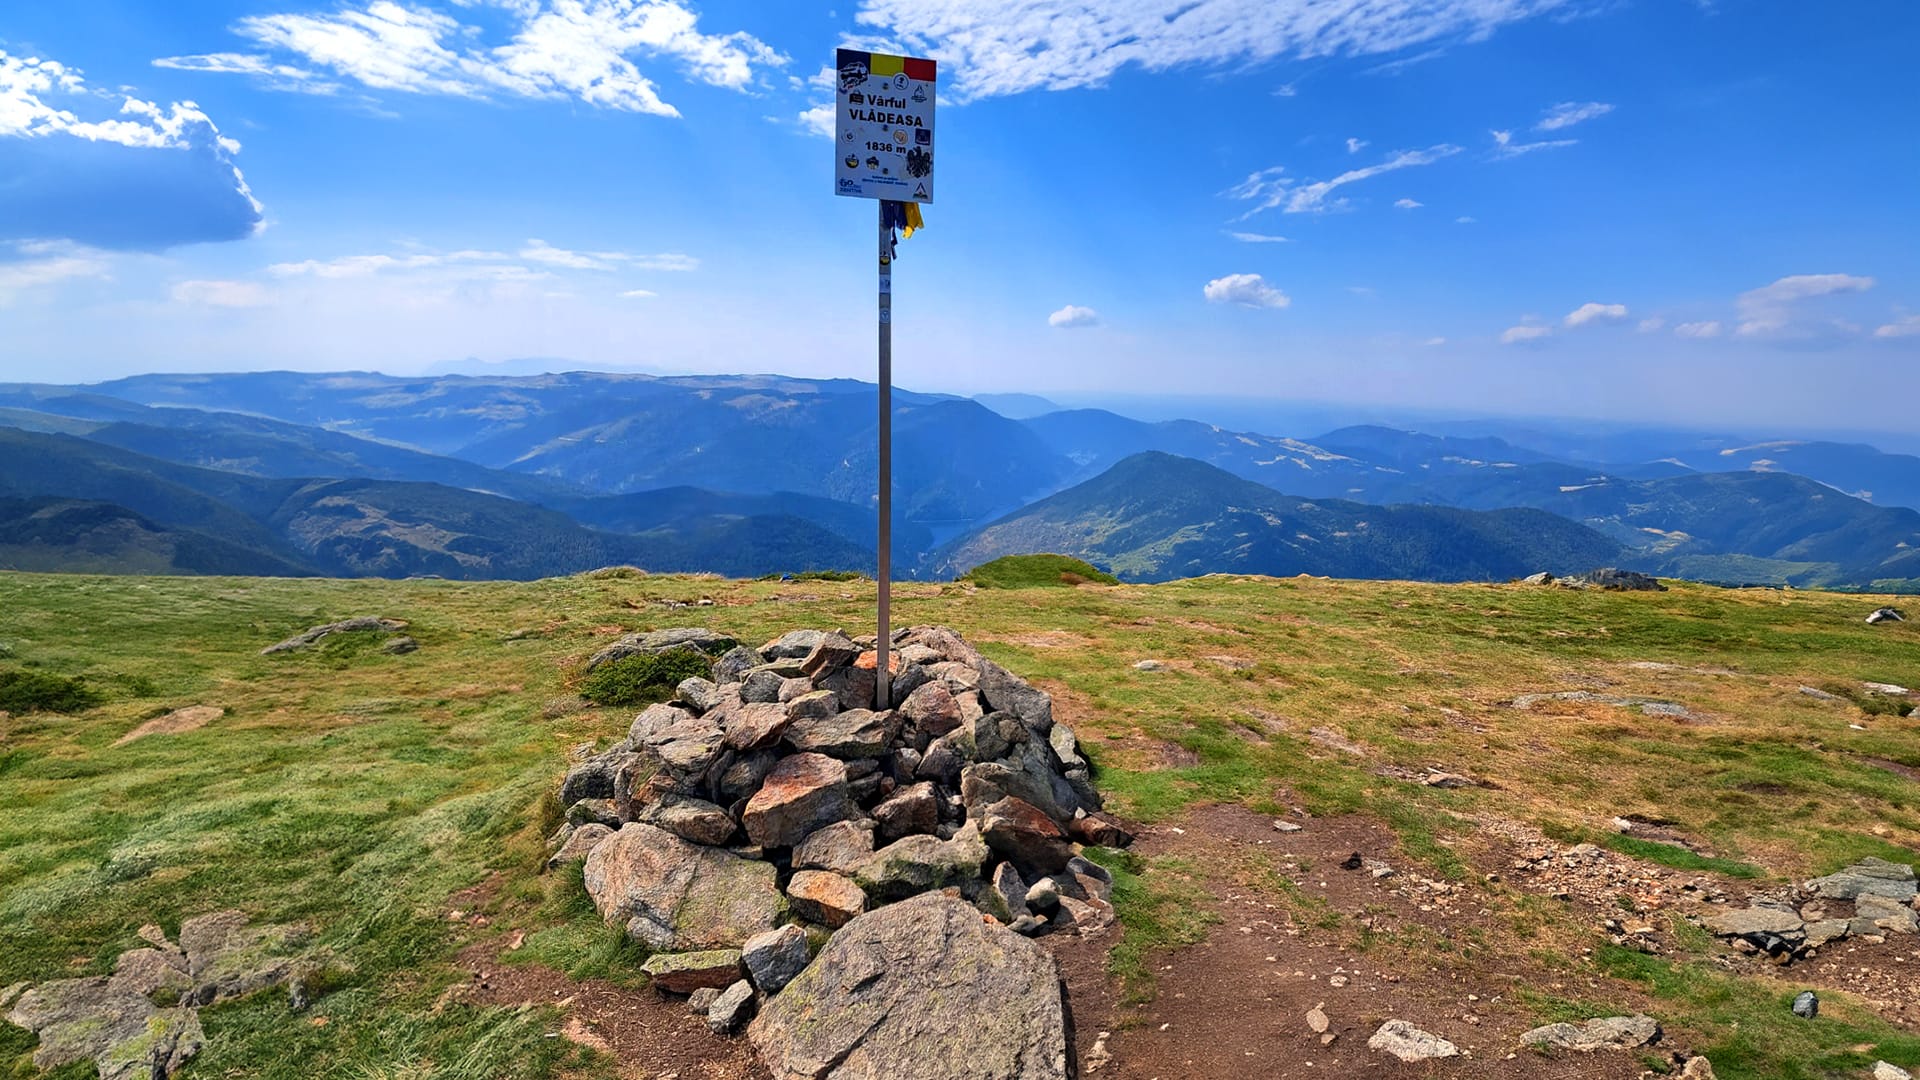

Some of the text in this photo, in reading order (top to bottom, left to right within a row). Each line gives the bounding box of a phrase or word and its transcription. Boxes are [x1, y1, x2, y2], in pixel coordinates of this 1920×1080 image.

[867, 94, 906, 109] Vârful
[865, 141, 906, 154] 1836 m
